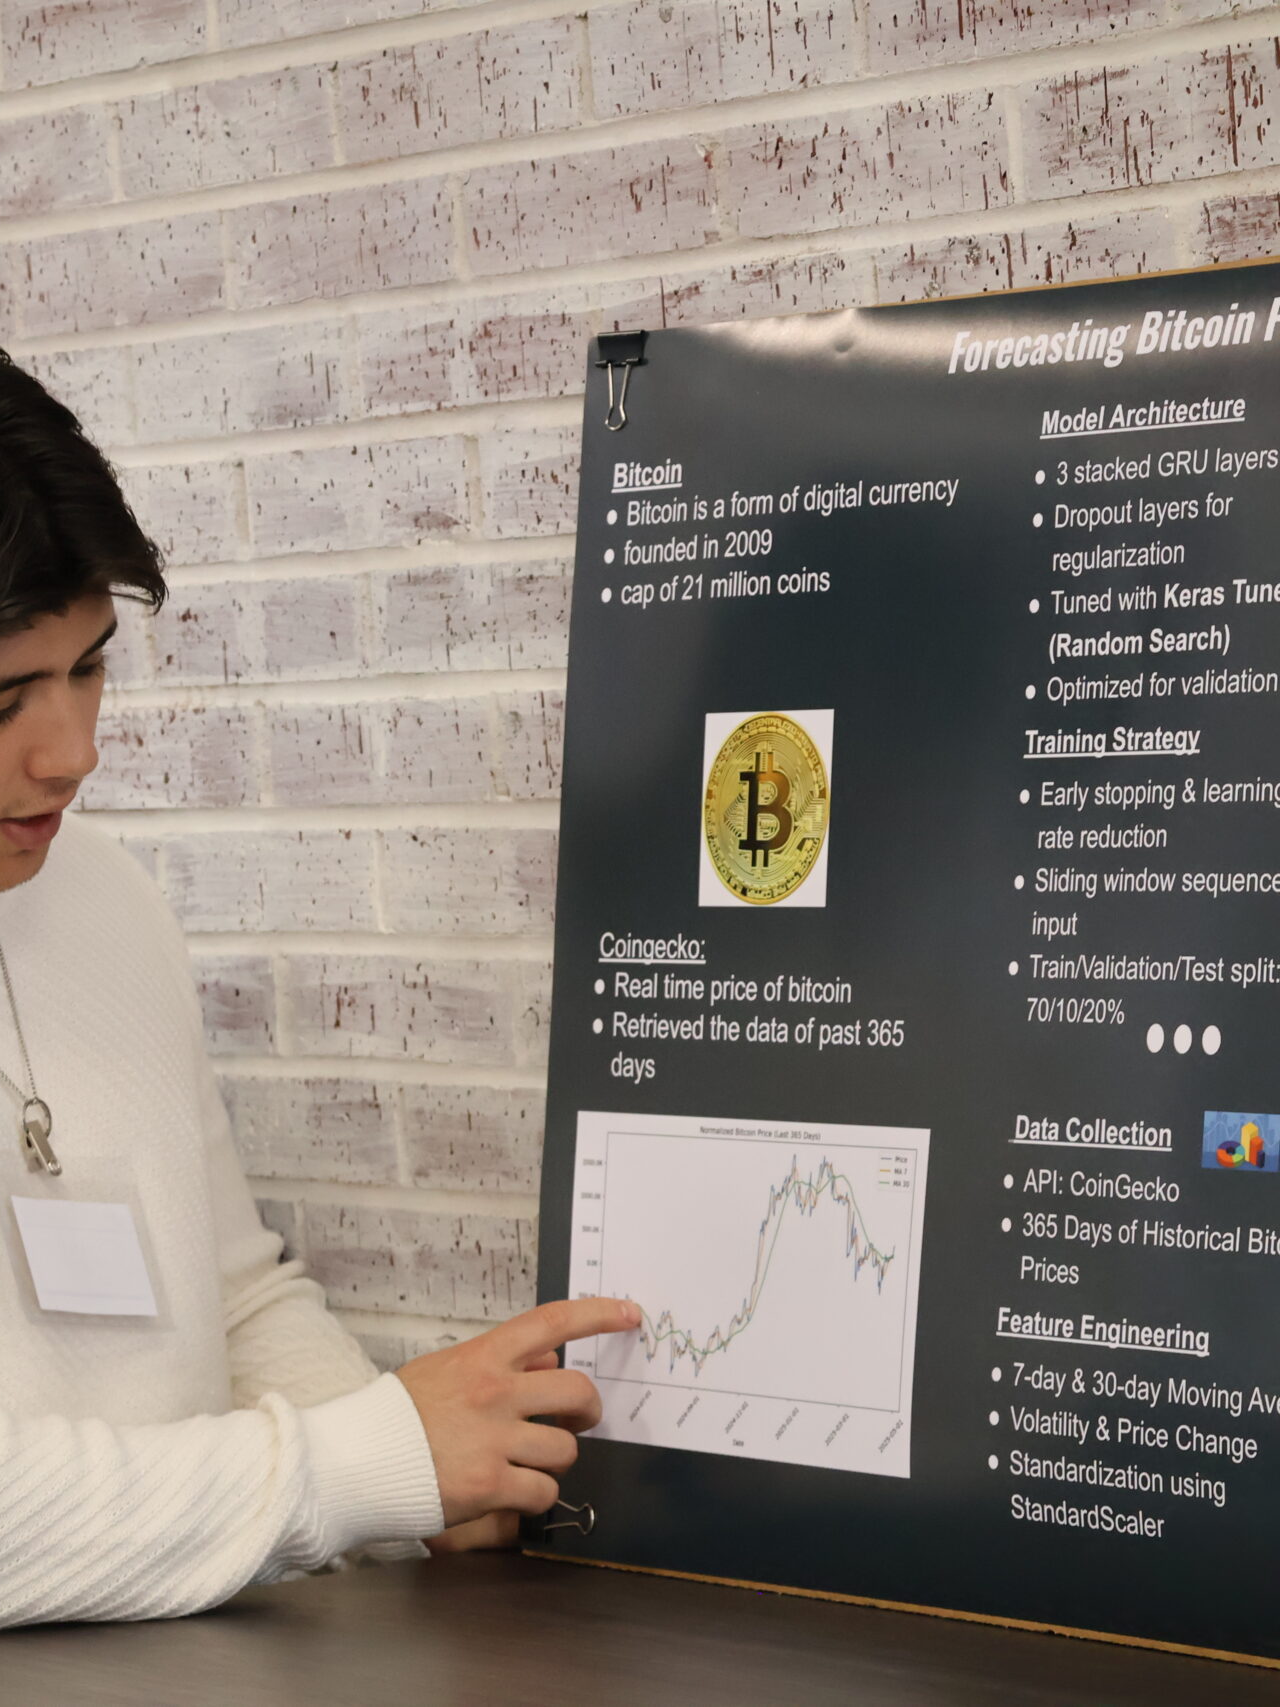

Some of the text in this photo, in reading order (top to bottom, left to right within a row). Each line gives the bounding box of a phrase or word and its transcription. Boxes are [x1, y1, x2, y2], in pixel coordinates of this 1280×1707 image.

[948, 319, 1131, 374] Forecasting
[1136, 303, 1256, 355] Bitcoin
[1041, 398, 1246, 434] Model Architecture
[613, 459, 682, 488] Bitcoin
[1056, 446, 1279, 485] 3 stacked GRU layers
[627, 479, 959, 526] Bitcoin is a form of digital currency
[1055, 492, 1234, 532] Dropout layers for
[624, 529, 772, 565] founded in 2009
[1052, 540, 1185, 577] regularization
[621, 566, 830, 609] cap of 21 million coins
[1051, 587, 1111, 614] Tuned
[1118, 586, 1157, 611] with
[1163, 583, 1225, 608] Keras
[1049, 624, 1230, 664] (Random Search)
[1046, 667, 1278, 706] Optimized for validation
[1025, 726, 1200, 757] Training Strategy
[1040, 781, 1089, 811] Early
[1094, 780, 1175, 810] stopping
[1182, 778, 1196, 803] &
[1037, 823, 1167, 849] rate reduction
[1035, 867, 1280, 898] Sliding window sequence
[1032, 911, 1078, 941] input
[600, 932, 705, 965] Coingecko:
[1029, 954, 1224, 982] Train/Validation/Test
[614, 972, 852, 1006] Real time price of bitcoin
[1027, 997, 1125, 1025] 70/10/20%
[612, 1011, 904, 1050] Retrieved the data of past 365
[610, 1051, 656, 1084] days
[1015, 1115, 1172, 1147] Data Collection
[1023, 1168, 1180, 1202] API: CoinGecko
[1022, 1212, 1280, 1256] 365 Days of Historical Bit
[1020, 1255, 1080, 1285] Prices
[997, 1307, 1210, 1357] Feature Engineering
[1013, 1362, 1067, 1397] 7-day
[1072, 1368, 1085, 1394] &
[1092, 1370, 1162, 1408] 30-day
[1168, 1377, 1243, 1417] Moving
[1010, 1405, 1258, 1463] Volatility & Price Change
[1009, 1450, 1226, 1507] Standardization using
[1010, 1494, 1165, 1538] StandardScaler
